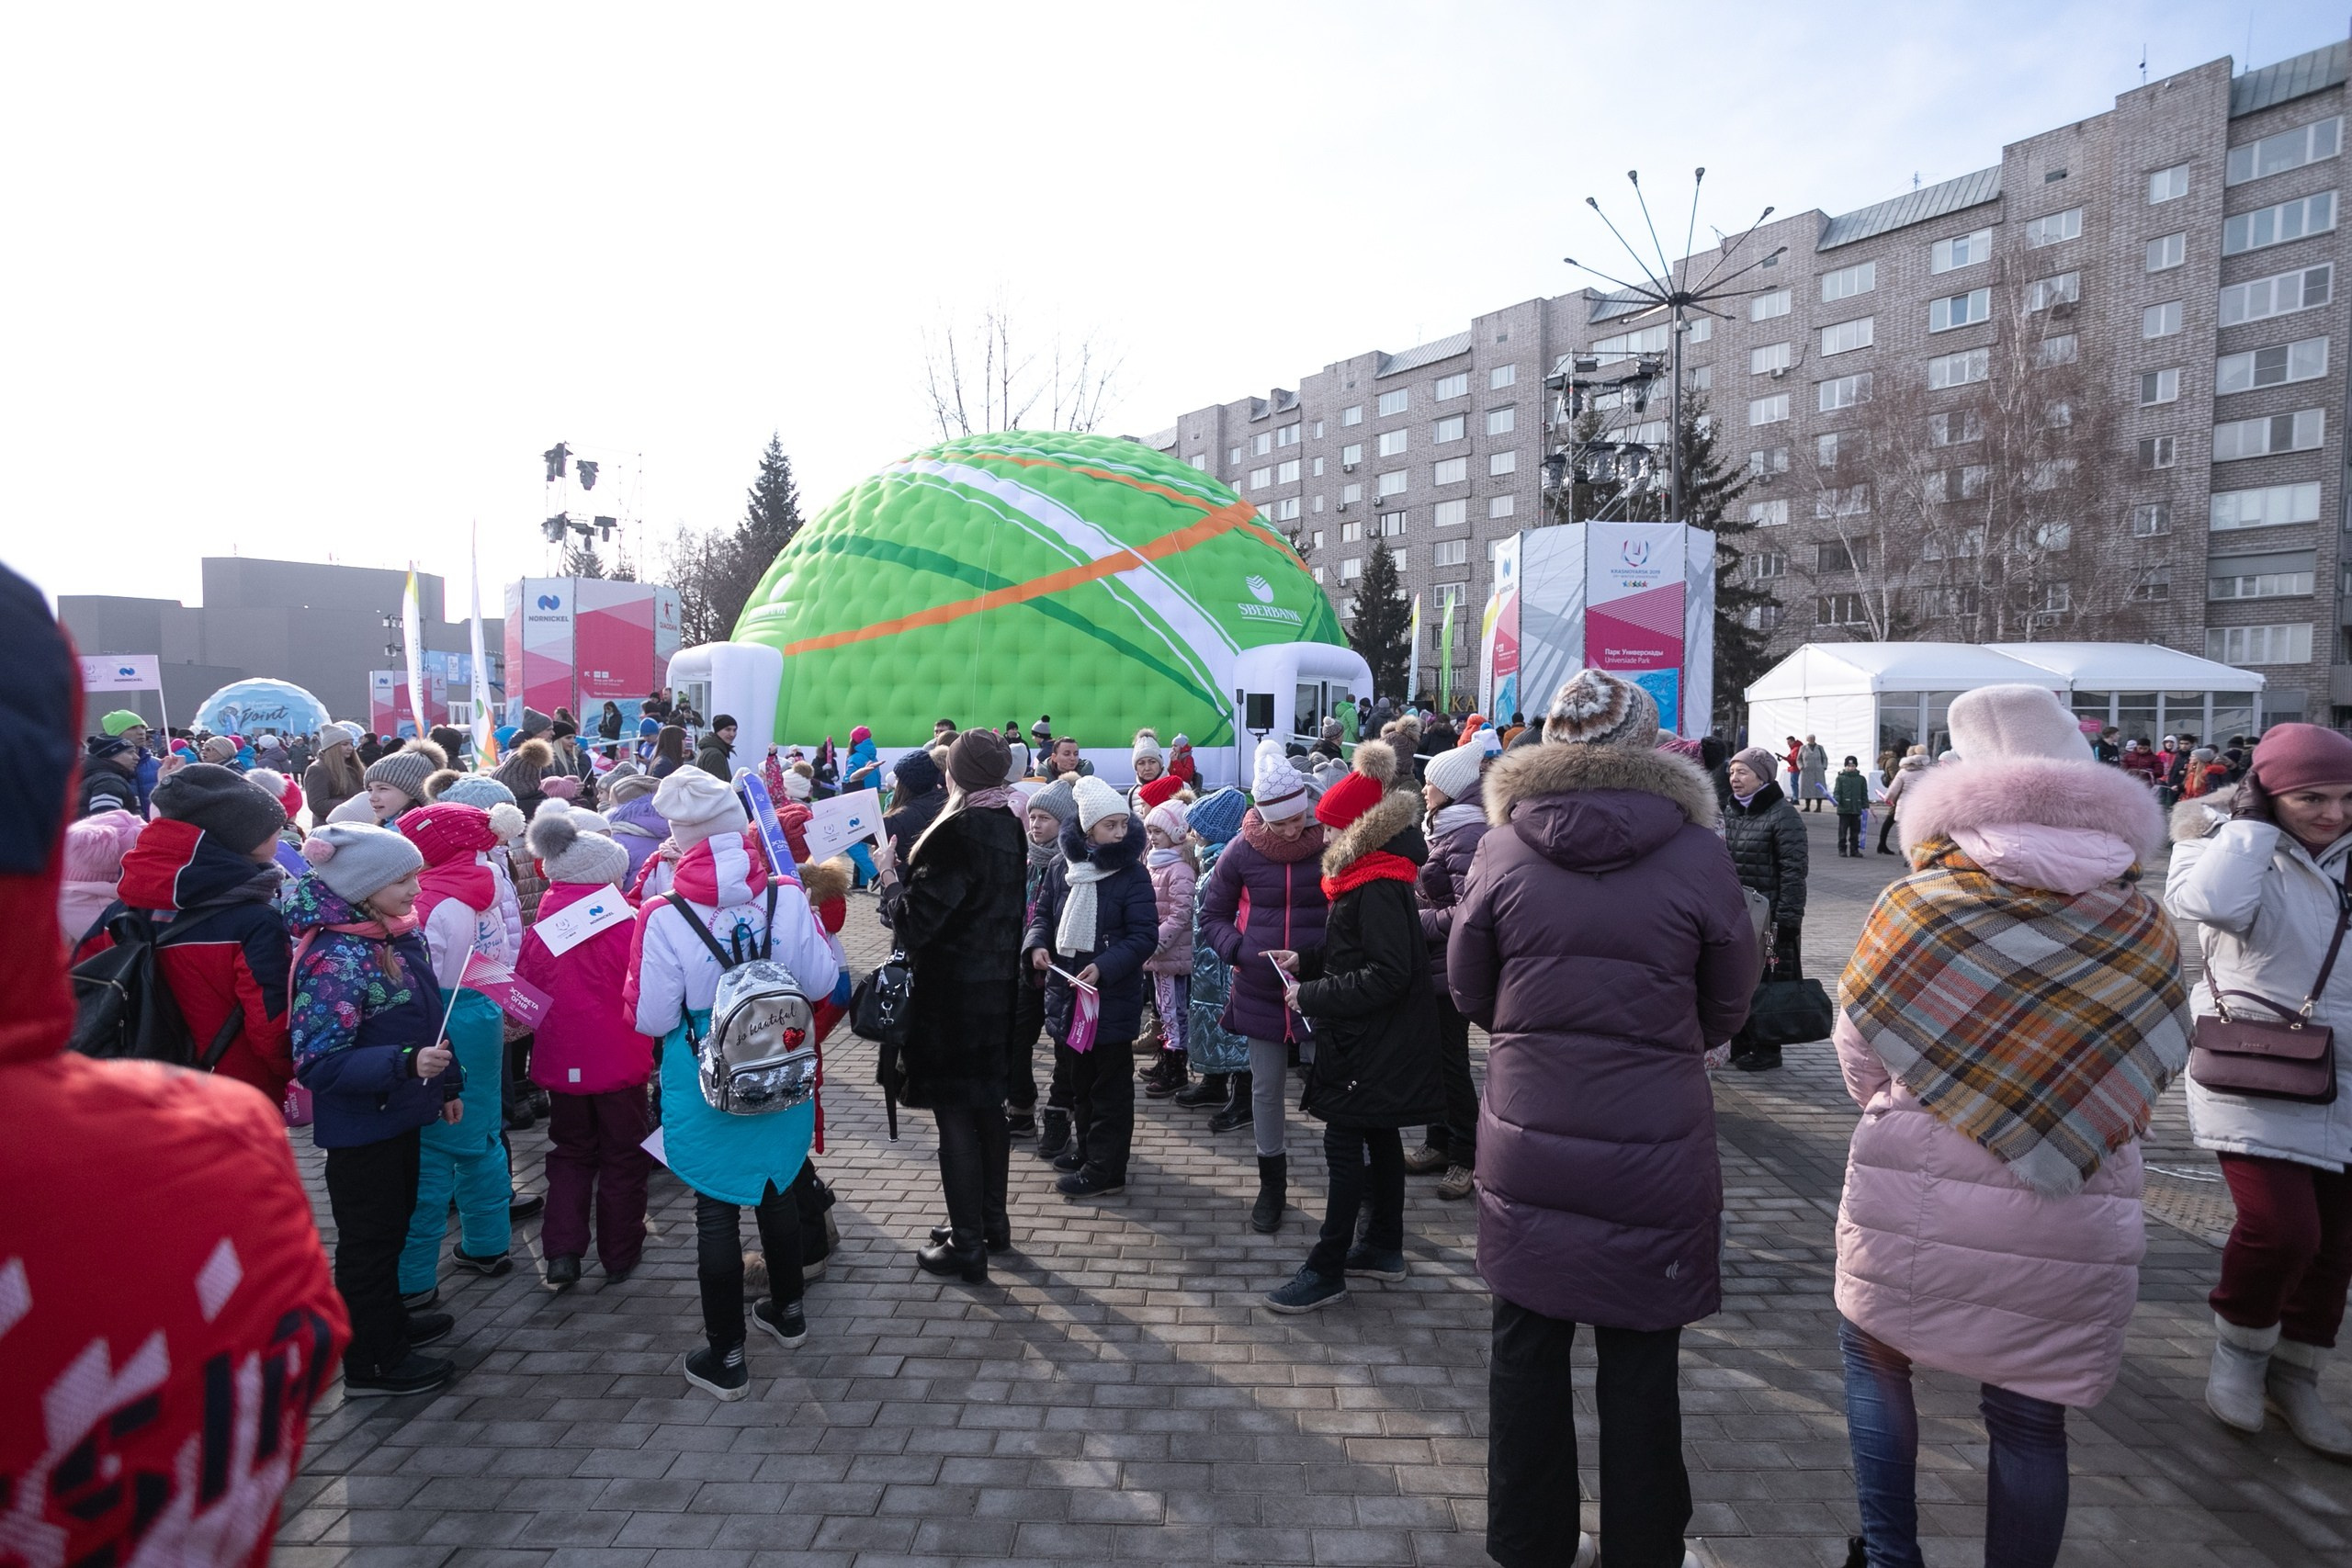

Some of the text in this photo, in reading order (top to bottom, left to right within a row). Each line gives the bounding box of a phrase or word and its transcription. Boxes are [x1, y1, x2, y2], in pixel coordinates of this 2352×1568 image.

[1238, 603, 1302, 623] SBERBANK
[1604, 648, 1664, 657] Парк Универсиады
[590, 911, 615, 925] NORNICKEL
[509, 986, 539, 1010] ЭСТАФЕТА
[511, 996, 528, 1010] ОГНЯ
[749, 1001, 797, 1036] beautiful
